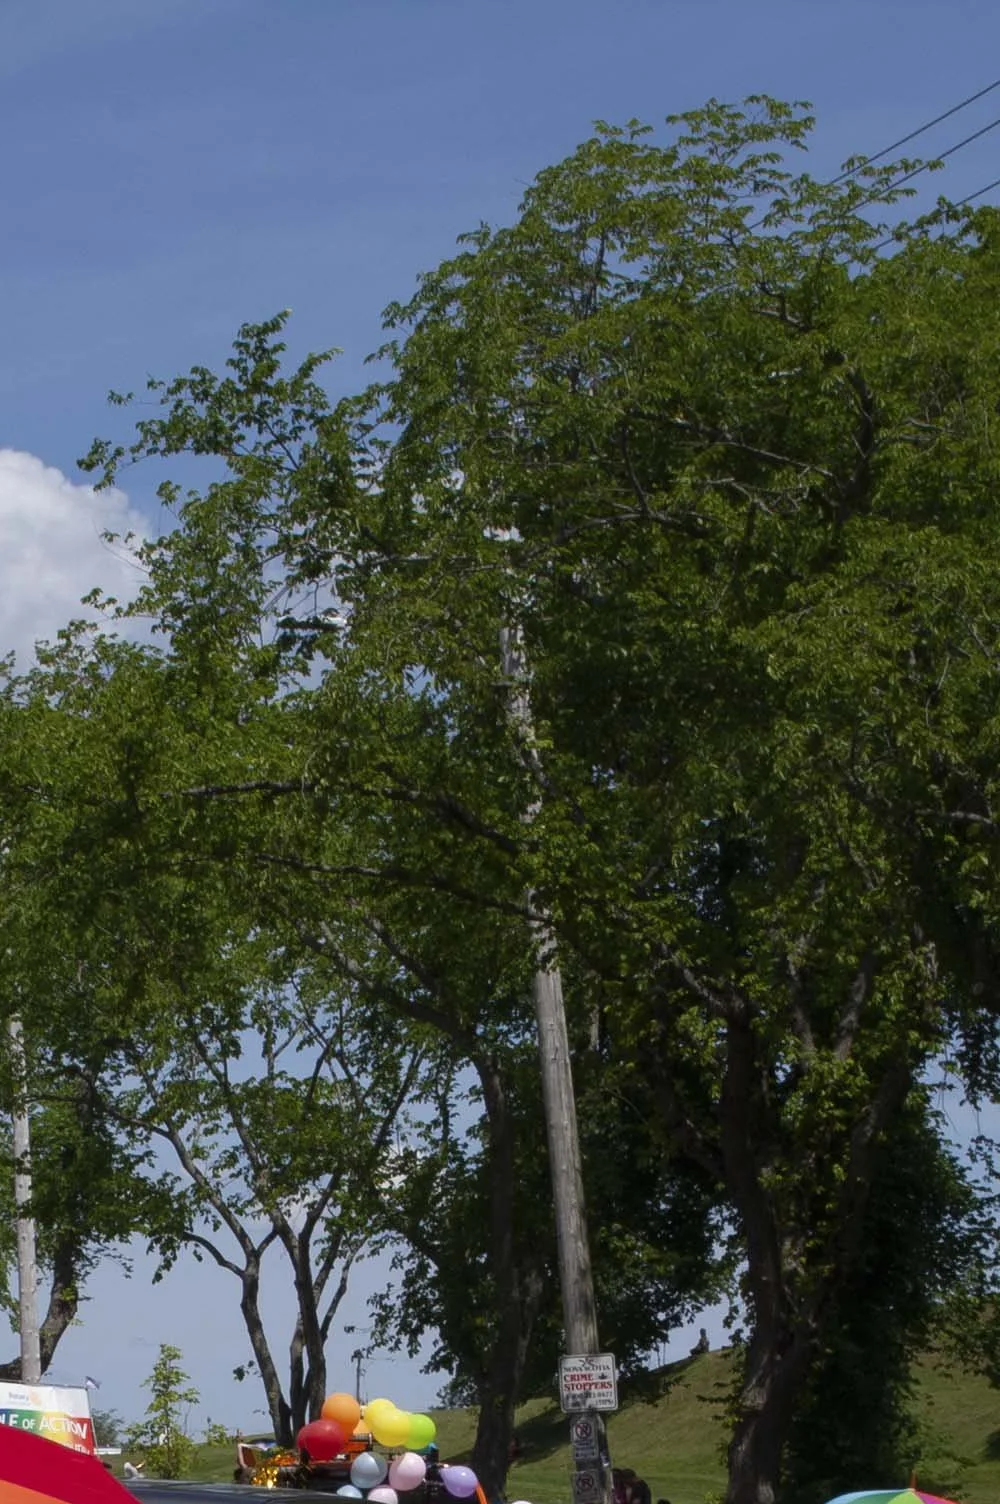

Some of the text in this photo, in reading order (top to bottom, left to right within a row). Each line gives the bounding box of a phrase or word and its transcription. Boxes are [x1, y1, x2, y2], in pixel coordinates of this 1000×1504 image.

[564, 1374, 593, 1383] CRIME
[564, 1382, 613, 1391] STOPPERS
[22, 1418, 37, 1430] OF
[39, 1415, 88, 1439] ACTION
